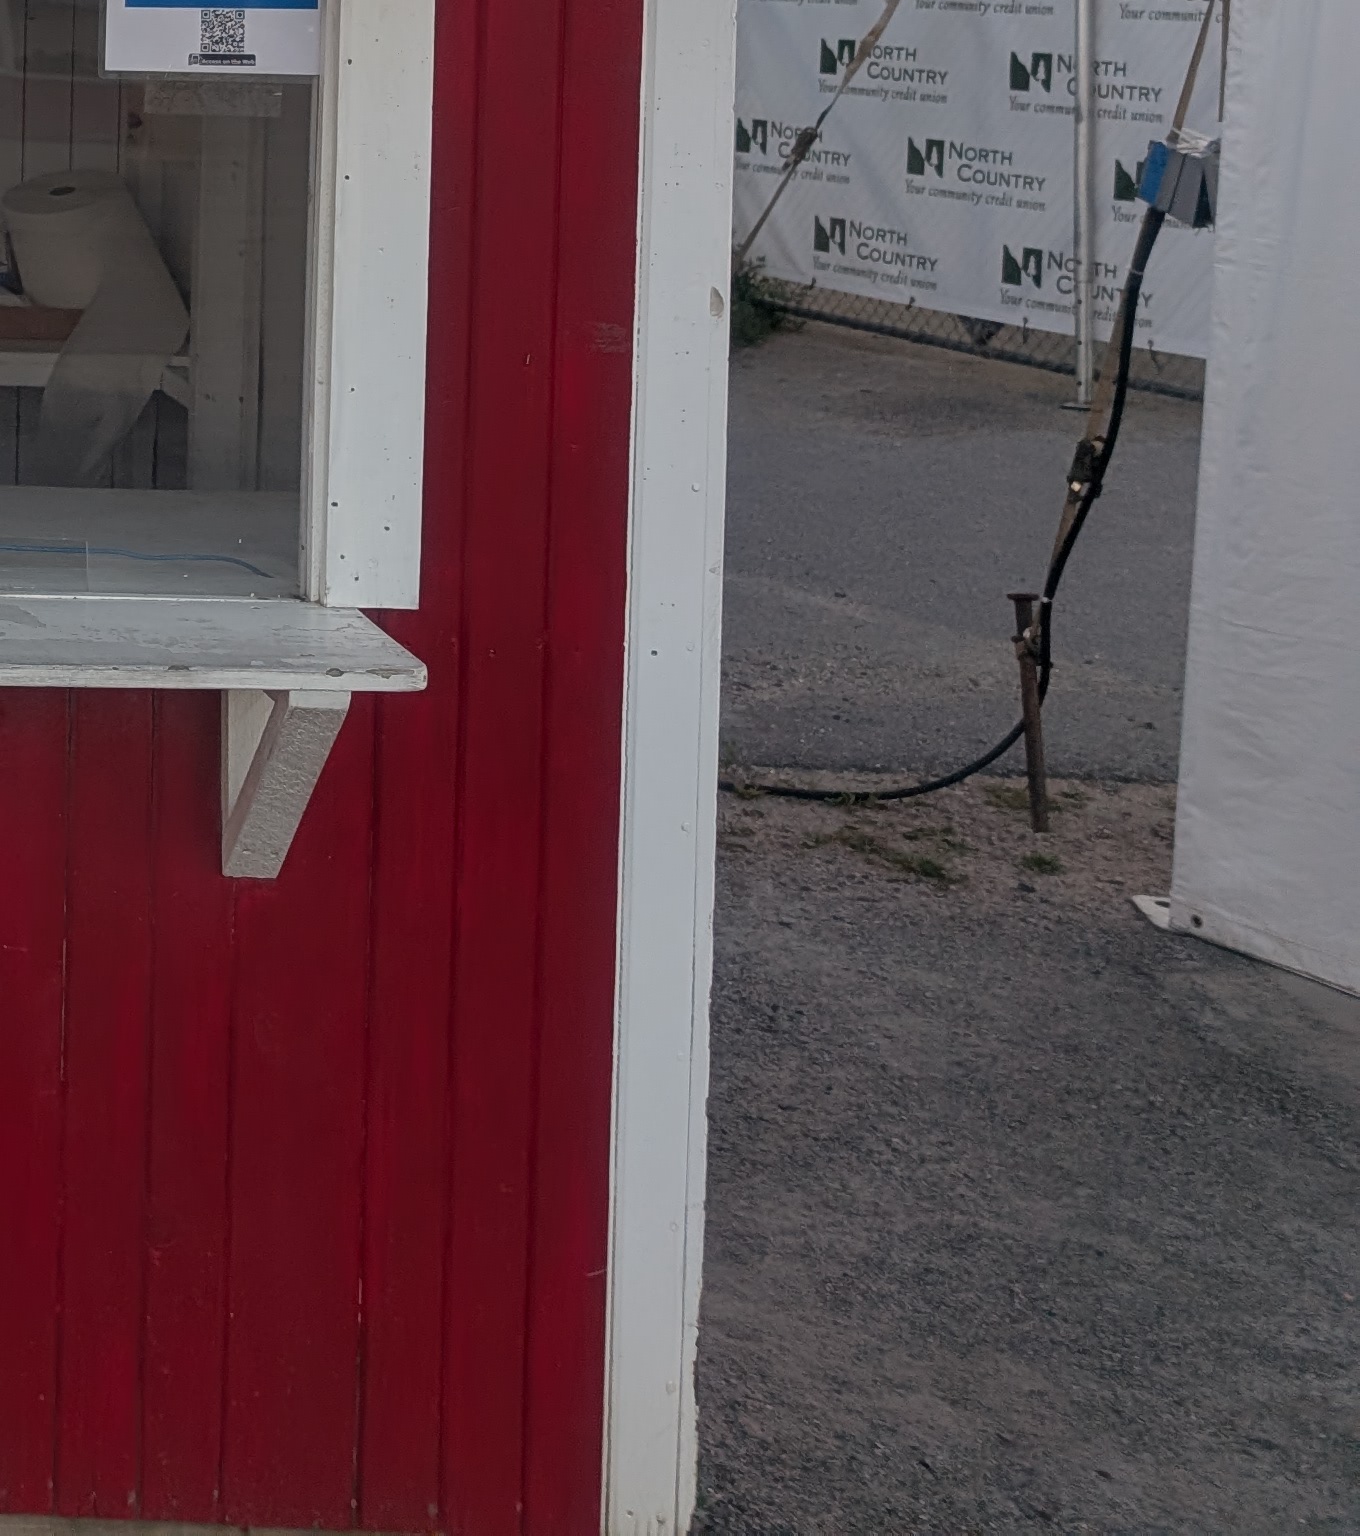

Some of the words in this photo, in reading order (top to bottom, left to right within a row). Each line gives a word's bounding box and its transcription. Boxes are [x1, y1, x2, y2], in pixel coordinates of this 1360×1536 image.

[938, 0, 990, 16] community
[1025, 3, 1054, 15] union
[1120, 3, 1142, 20] Your
[1148, 8, 1204, 23] communit
[869, 44, 917, 62] ORTH
[1056, 54, 1127, 77] NRTH
[867, 61, 949, 85] COUNTRY
[818, 78, 838, 94] Your
[842, 84, 890, 102] mmunity
[891, 85, 917, 102] credit
[920, 93, 948, 104] union
[1067, 76, 1163, 103] CUNTRY
[1009, 96, 1031, 112] Your
[1097, 104, 1127, 121] credit
[1130, 109, 1163, 124] union
[771, 120, 823, 144] NOH
[778, 141, 851, 167] CUNTRY
[948, 140, 1013, 166] NORTH
[800, 167, 823, 182] credit
[957, 164, 1046, 192] COUNTRY
[905, 178, 926, 194] Your
[928, 186, 983, 206] community
[985, 191, 1012, 208] credit
[1016, 199, 1046, 212] union
[1111, 205, 1136, 223] Your
[849, 219, 907, 246] NORTH
[857, 242, 938, 272] COUNTRY
[1047, 251, 1118, 279] NOTH
[832, 264, 879, 283] community
[880, 270, 908, 287] credit
[1000, 288, 1023, 306] Your
[1056, 275, 1153, 308] CUNY
